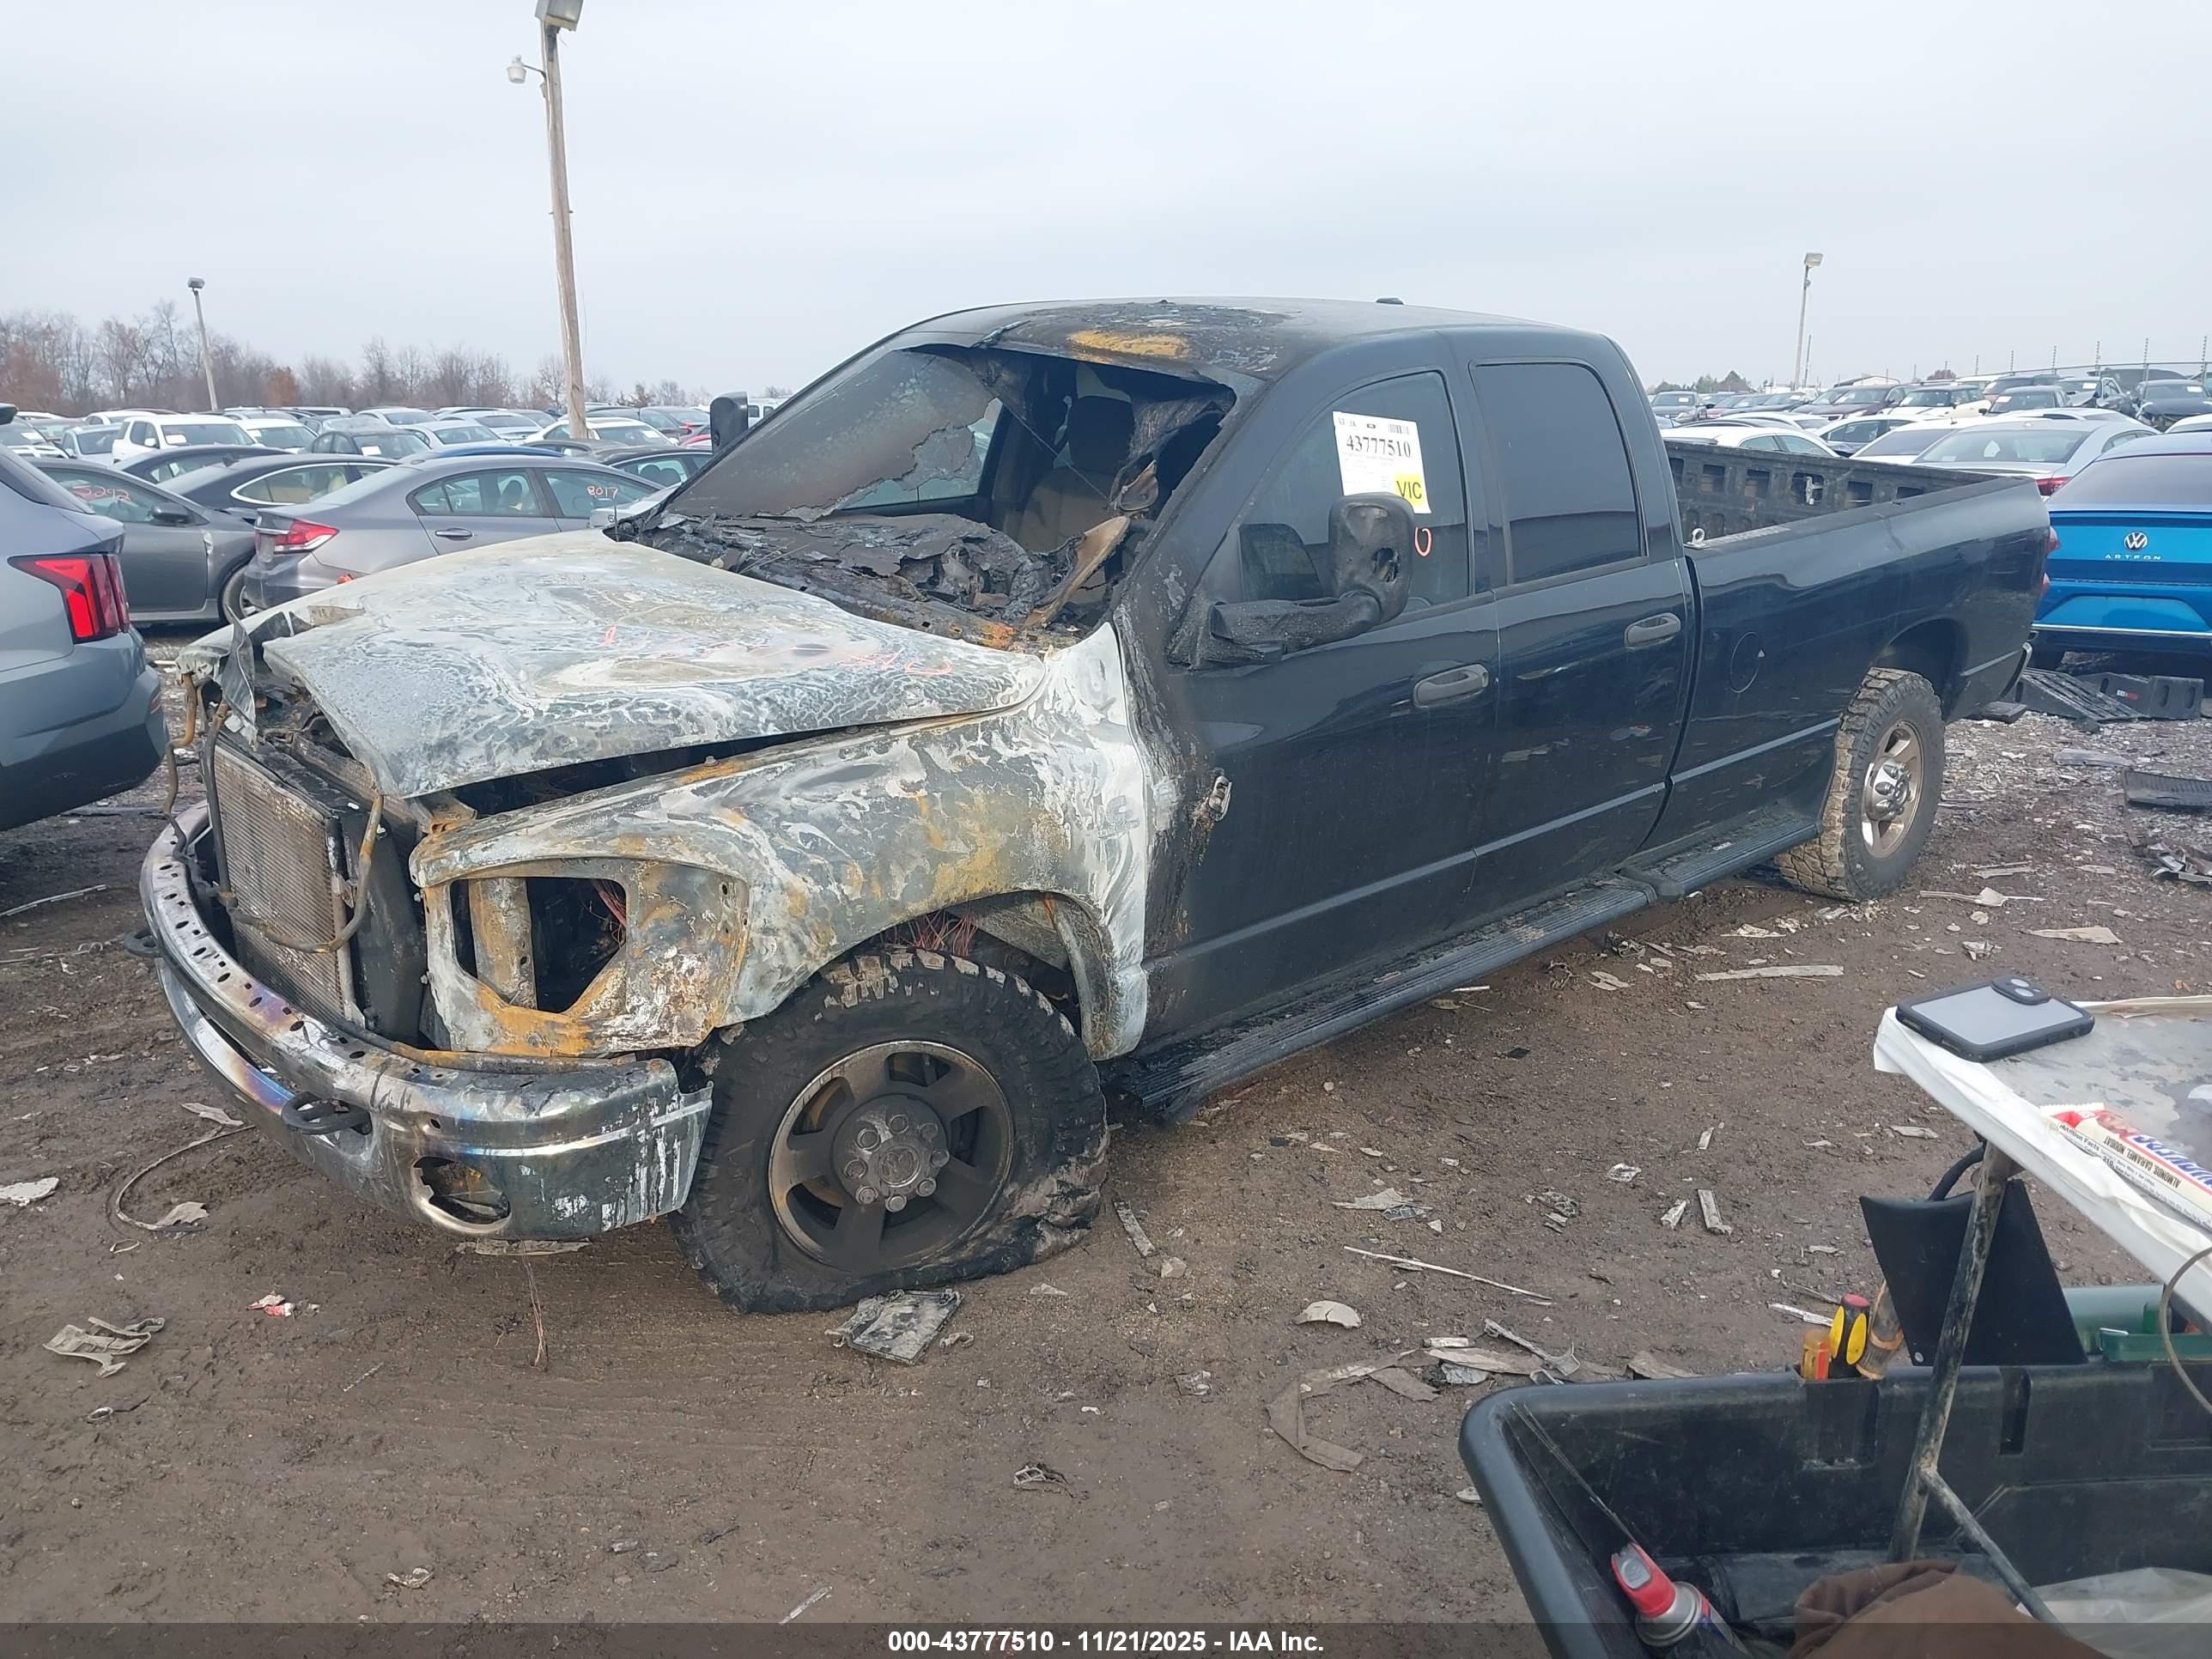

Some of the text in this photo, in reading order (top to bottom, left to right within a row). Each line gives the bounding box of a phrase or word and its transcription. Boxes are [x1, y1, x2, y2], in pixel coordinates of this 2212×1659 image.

[1346, 434, 1411, 458] 43777510
[586, 485, 619, 499] 8017
[1396, 480, 1423, 500] VIC
[2083, 1137, 2100, 1152] Facts
[2103, 1135, 2127, 1155] NOUGAT
